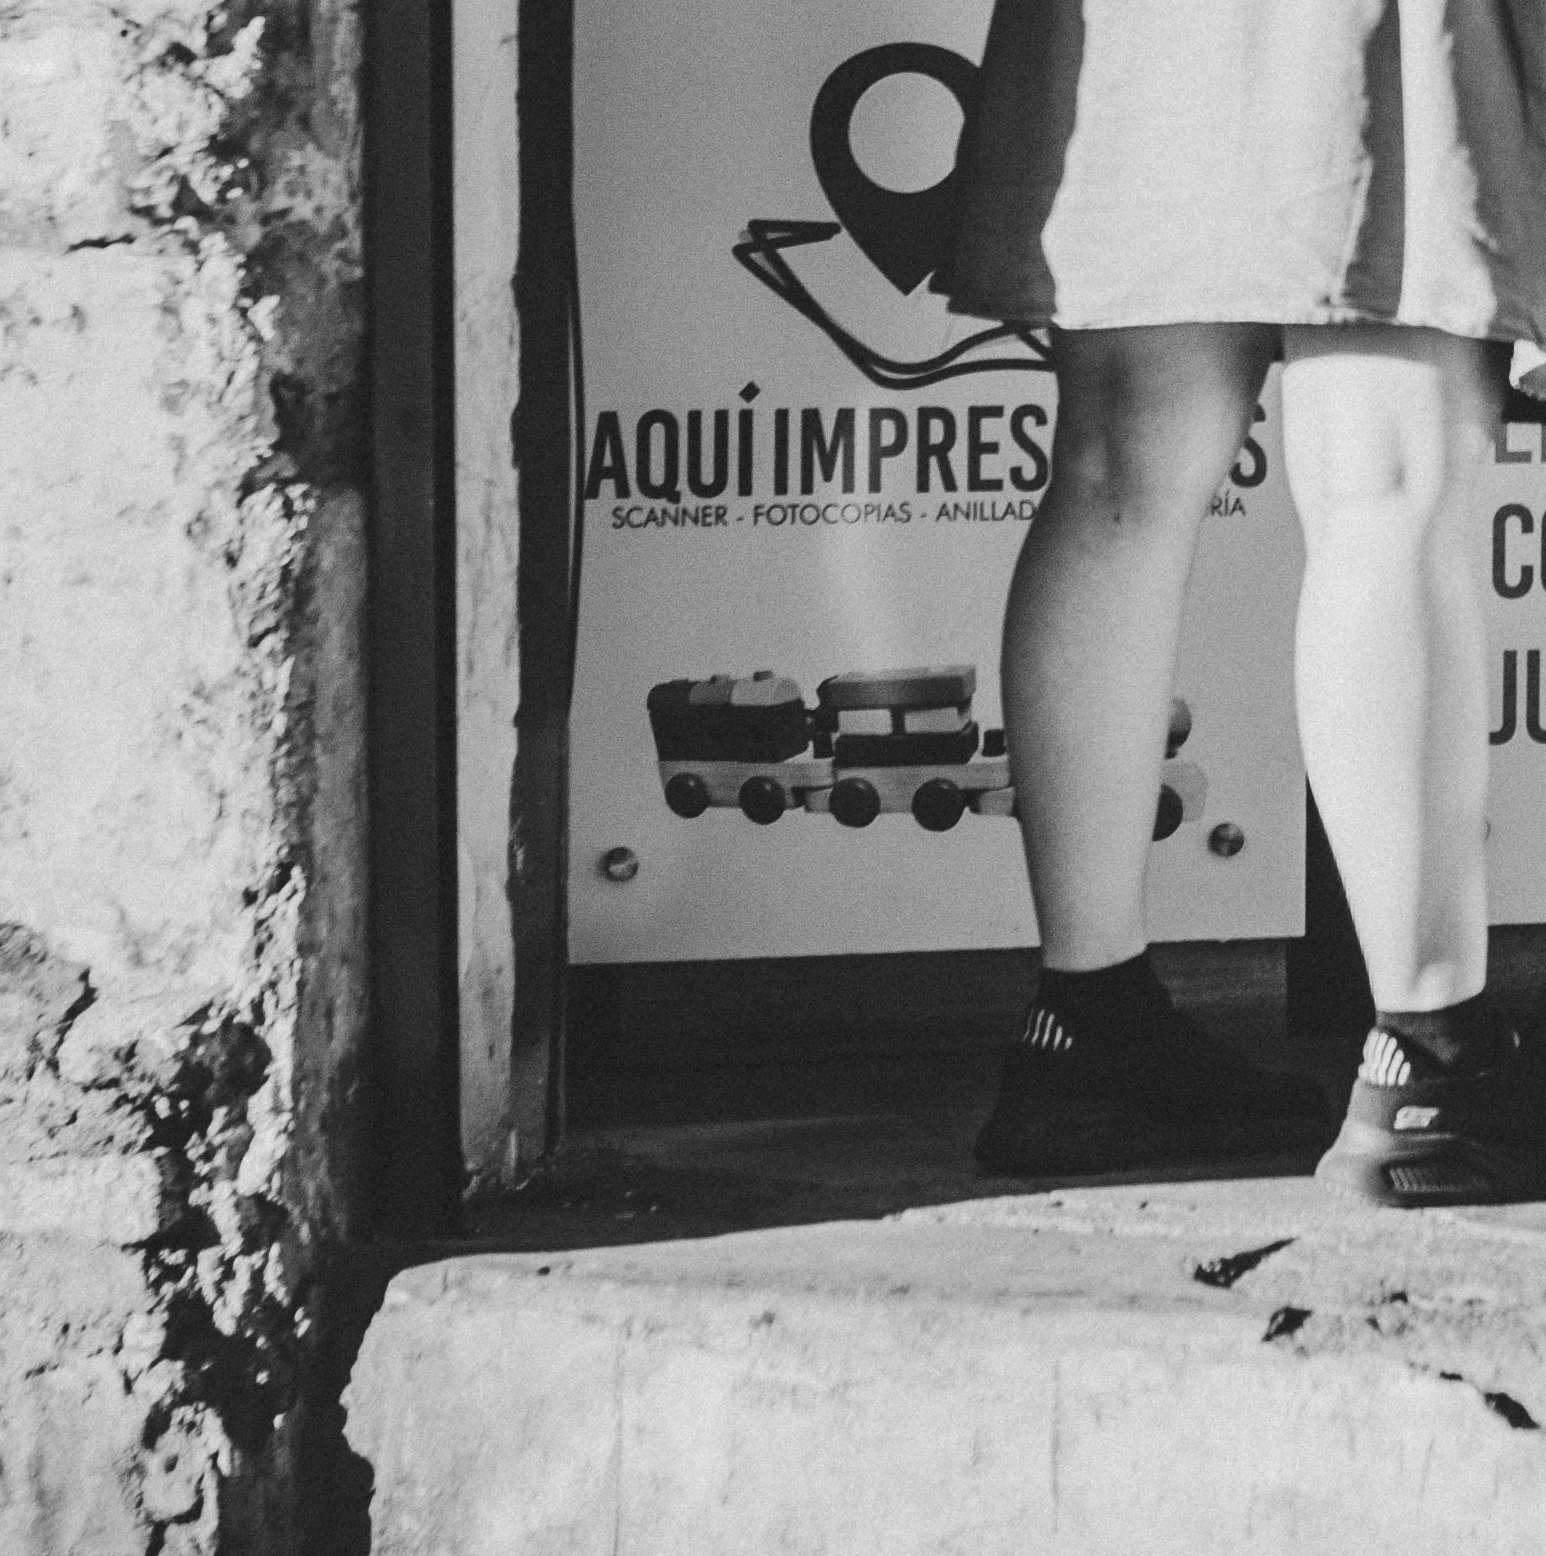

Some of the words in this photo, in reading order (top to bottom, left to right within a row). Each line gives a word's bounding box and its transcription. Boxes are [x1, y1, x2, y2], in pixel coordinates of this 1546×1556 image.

[611, 503, 728, 530] SCANNER
[752, 501, 913, 527] FOTOCOPIAS
[935, 499, 1037, 522] ANILLAD
